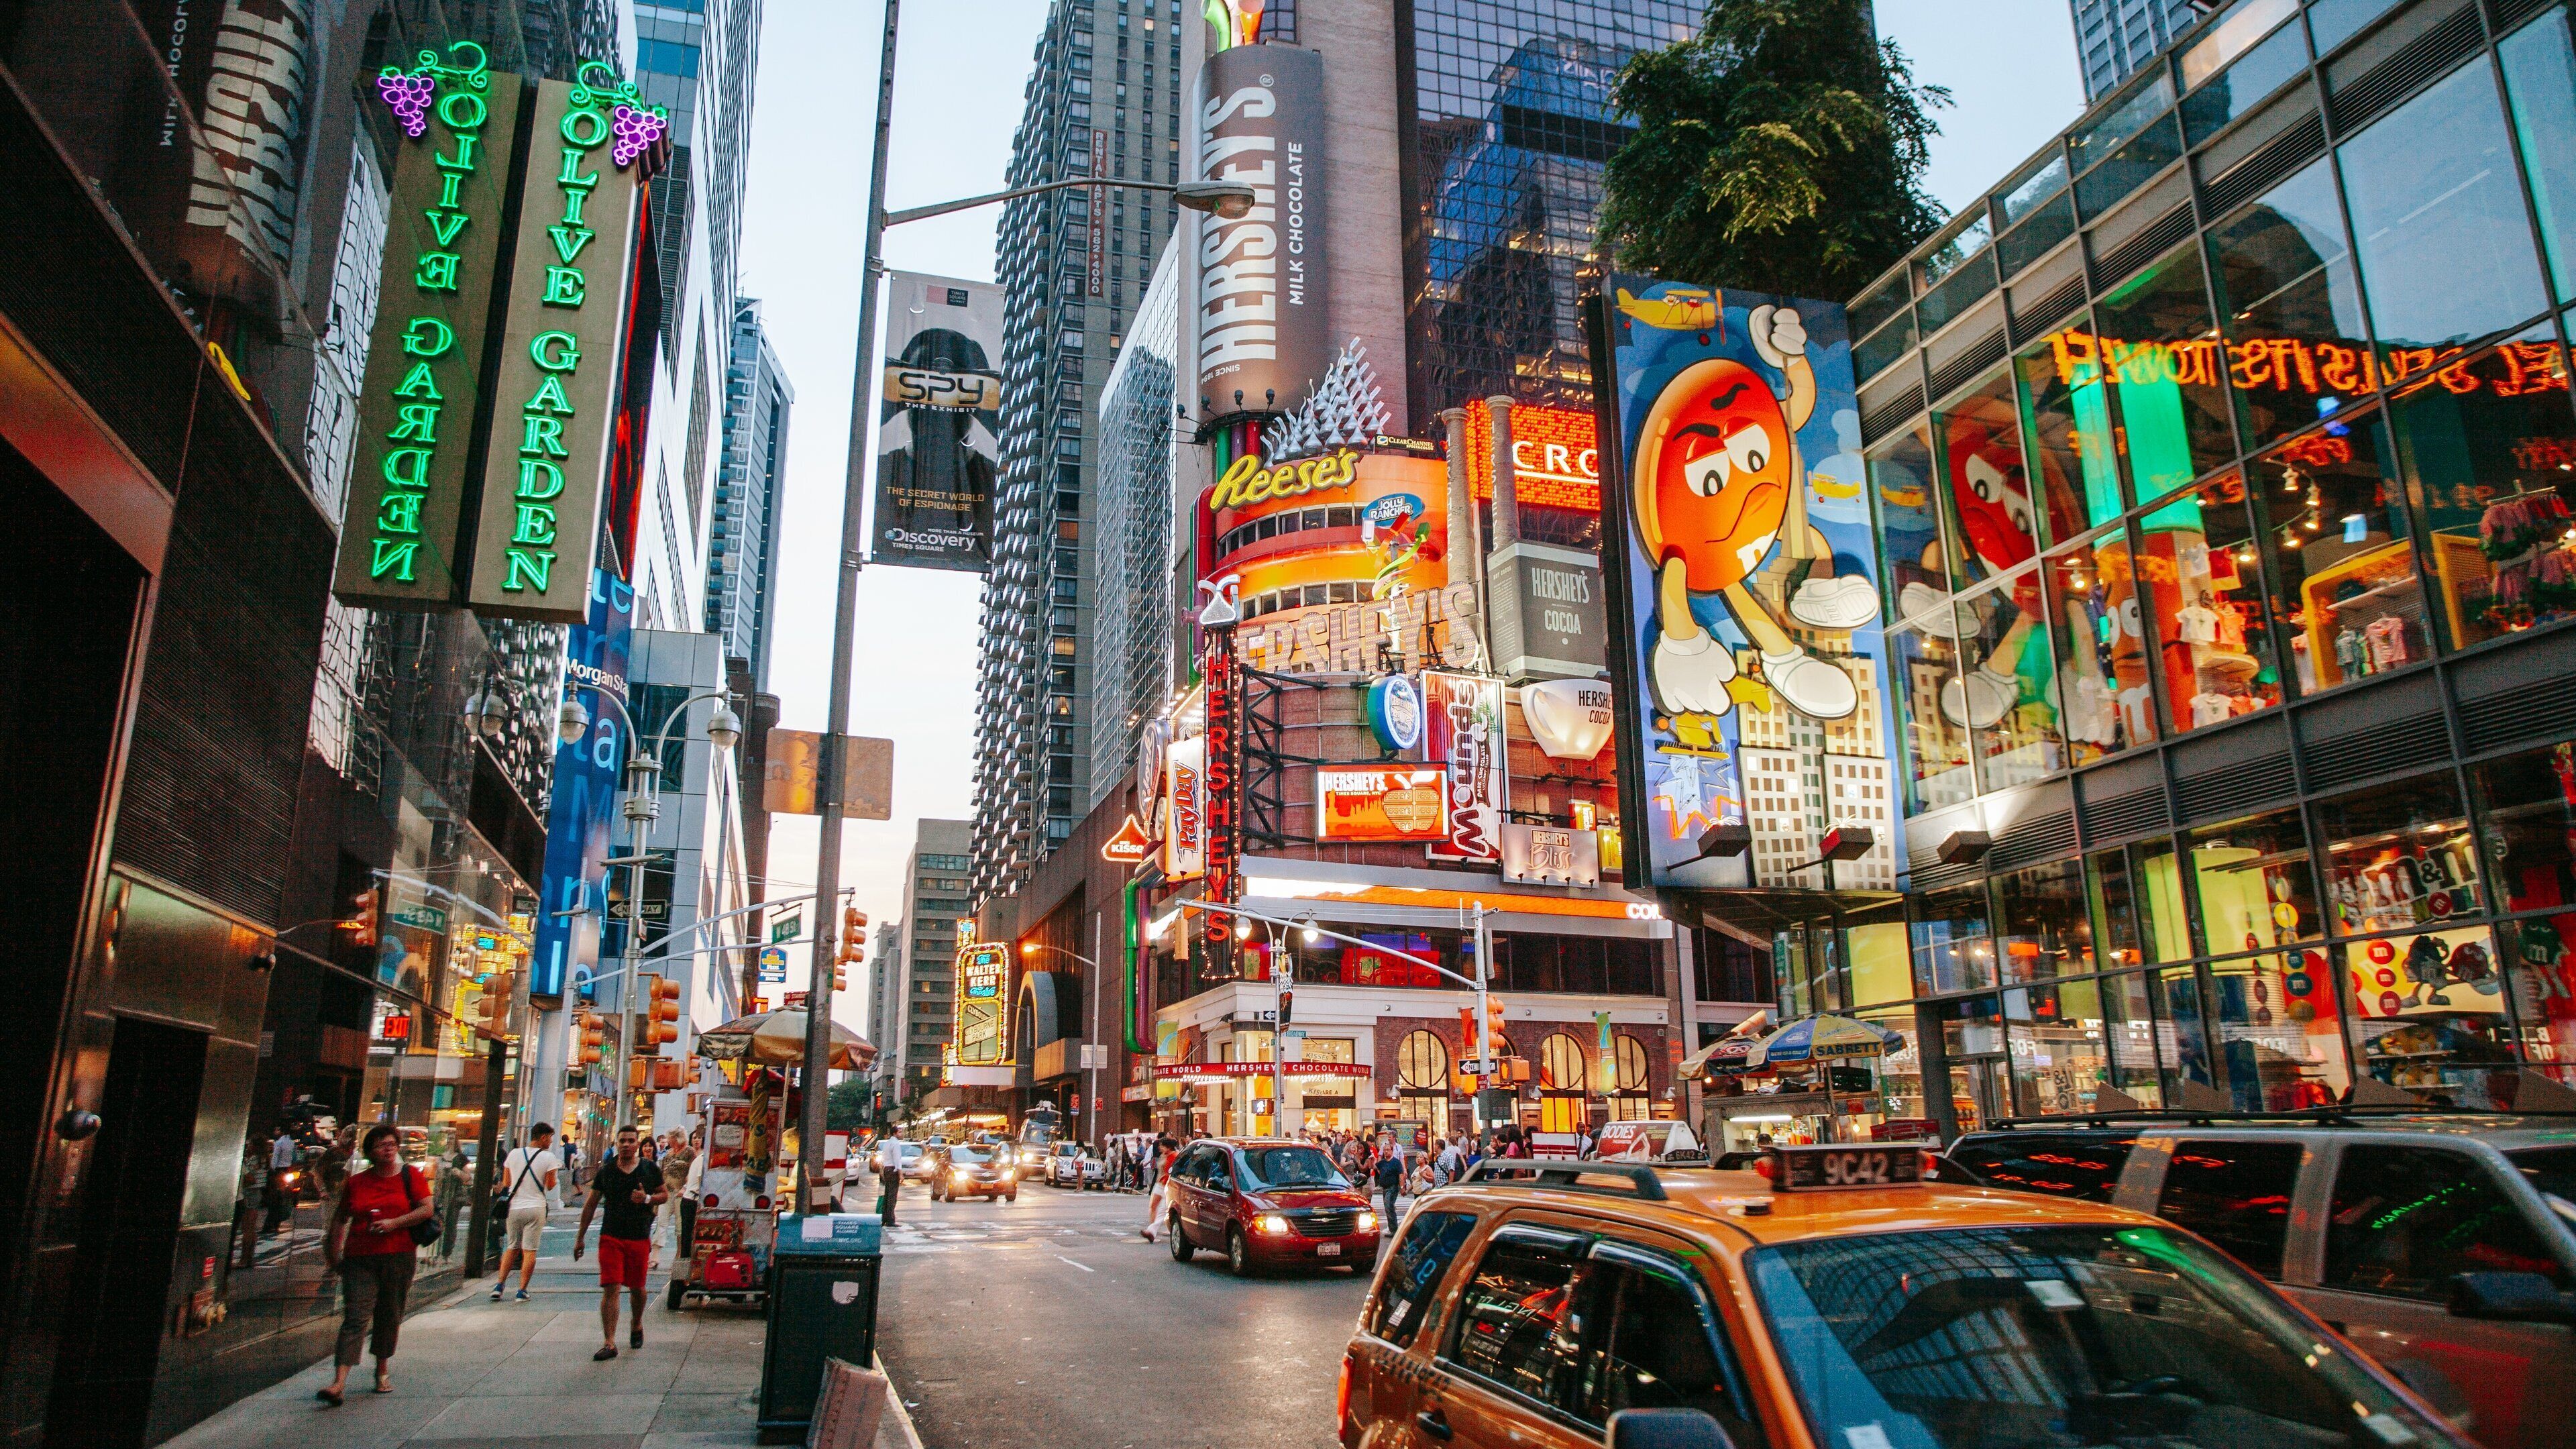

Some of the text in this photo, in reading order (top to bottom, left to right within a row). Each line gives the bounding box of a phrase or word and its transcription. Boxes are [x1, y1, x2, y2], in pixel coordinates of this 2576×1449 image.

[1095, 132, 1104, 180] RENTAL
[1093, 184, 1102, 217] APTS
[1288, 142, 1304, 306] MILK CHOCOLATE
[501, 110, 609, 594] OLIVE GARDEN
[1215, 364, 1240, 377] SINCE
[899, 372, 984, 405] SPY
[1210, 447, 1360, 513] Reese's
[887, 486, 985, 502] THE SECRET WORLD
[899, 498, 971, 512] OF ESPIONAGE
[1370, 504, 1413, 521] RANCHER
[1377, 497, 1405, 512] JOLLY
[915, 544, 945, 552] SQUARE
[1532, 568, 1590, 604] HERSHEY'S
[1544, 610, 1581, 634] COCOA
[1579, 690, 1613, 706] HERSHE
[1589, 710, 1611, 724] COCOA
[1448, 680, 1489, 856] Mounds
[1477, 745, 1486, 779] CHOCOLATE
[1174, 762, 1201, 851] PayDay
[1533, 830, 1570, 847] HERSHEY'S
[1528, 844, 1574, 871] Bliss
[966, 964, 1000, 976] WALTER
[970, 975, 996, 987] KERR
[386, 1018, 409, 1036] EXIT
[972, 1030, 986, 1041] PARK
[1305, 1053, 1329, 1061] KISSES
[1815, 1042, 1879, 1056] SABRETT
[1172, 1065, 1201, 1073] WORLD
[1292, 1064, 1348, 1073] CHOCOLATE
[1352, 1066, 1369, 1074] WORLD
[1602, 1125, 1637, 1138] BODIES
[1823, 1152, 1890, 1185] 9C42
